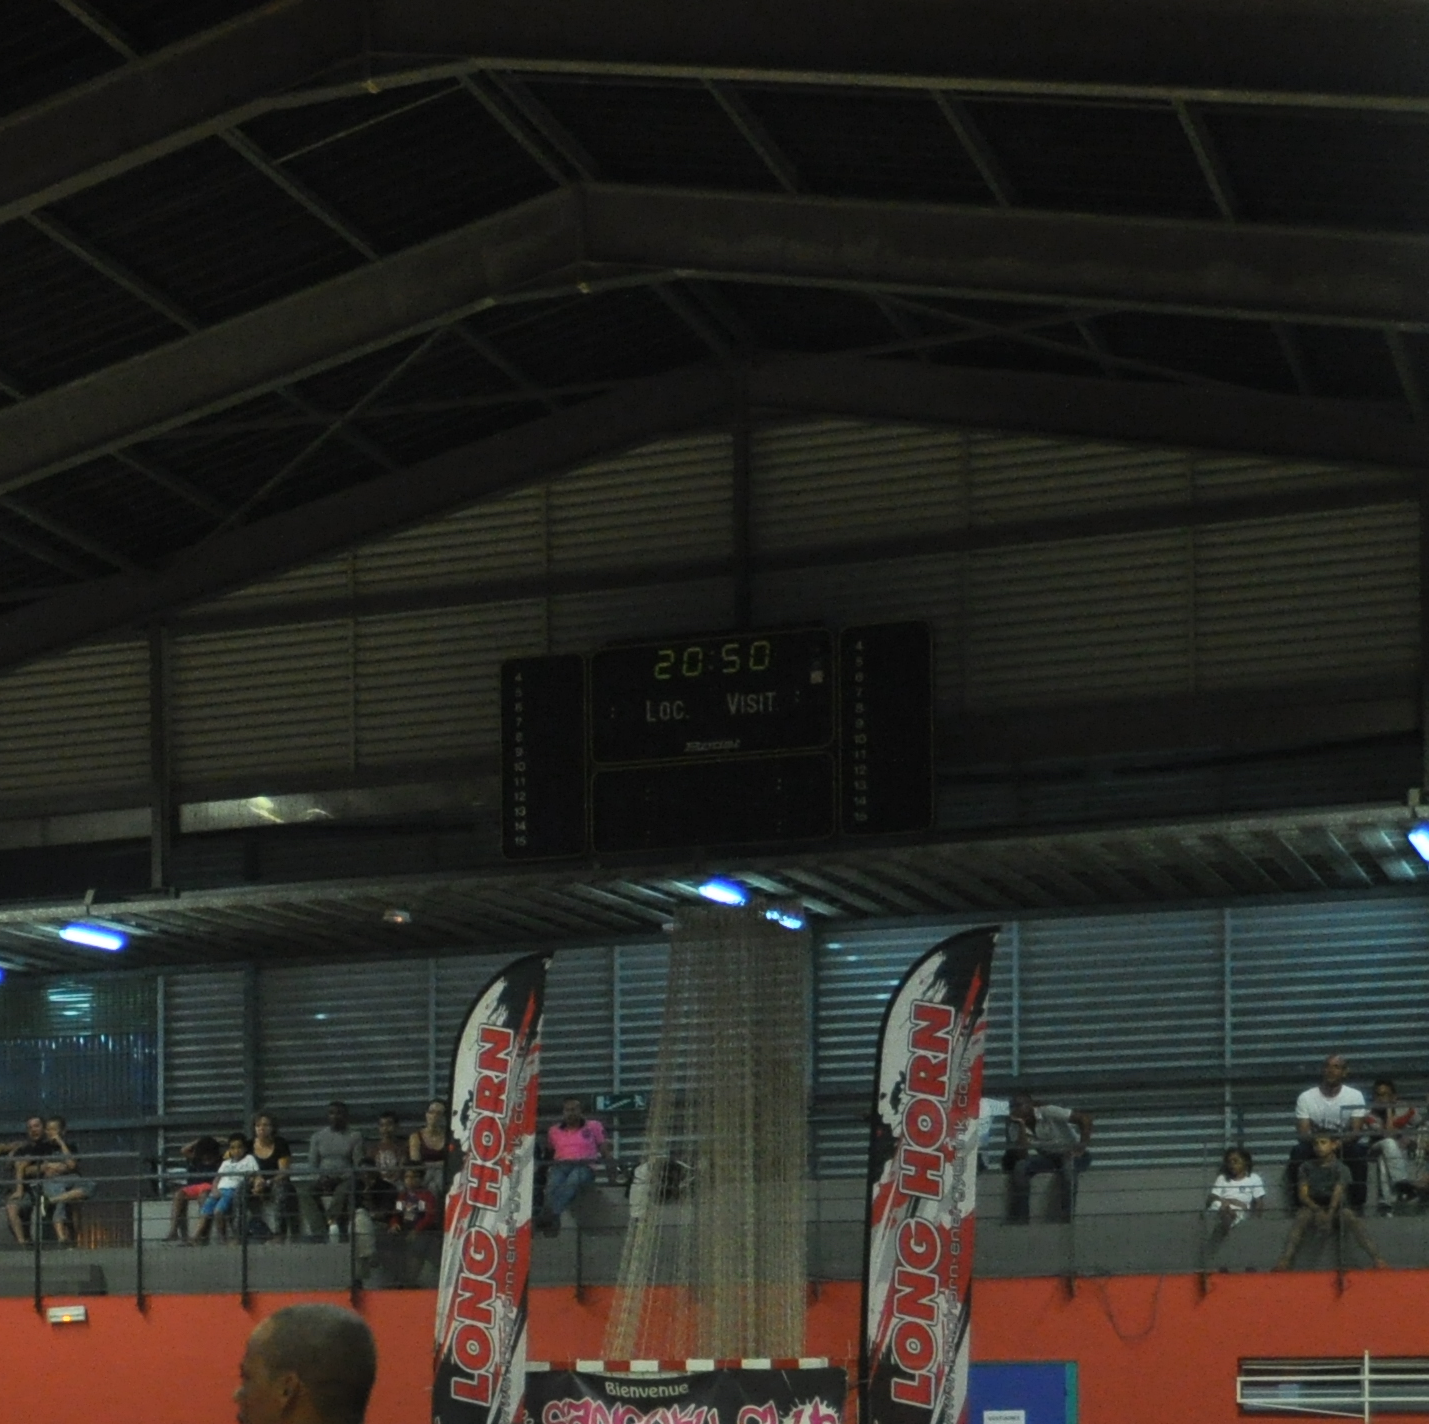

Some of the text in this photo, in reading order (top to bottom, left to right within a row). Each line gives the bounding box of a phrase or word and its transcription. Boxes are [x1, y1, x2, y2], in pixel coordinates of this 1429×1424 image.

[654, 641, 771, 680] 20:50
[450, 1025, 516, 1408] LONG HORN
[891, 1001, 955, 1408] LONG HORN
[604, 1381, 690, 1399] Bienvenue
